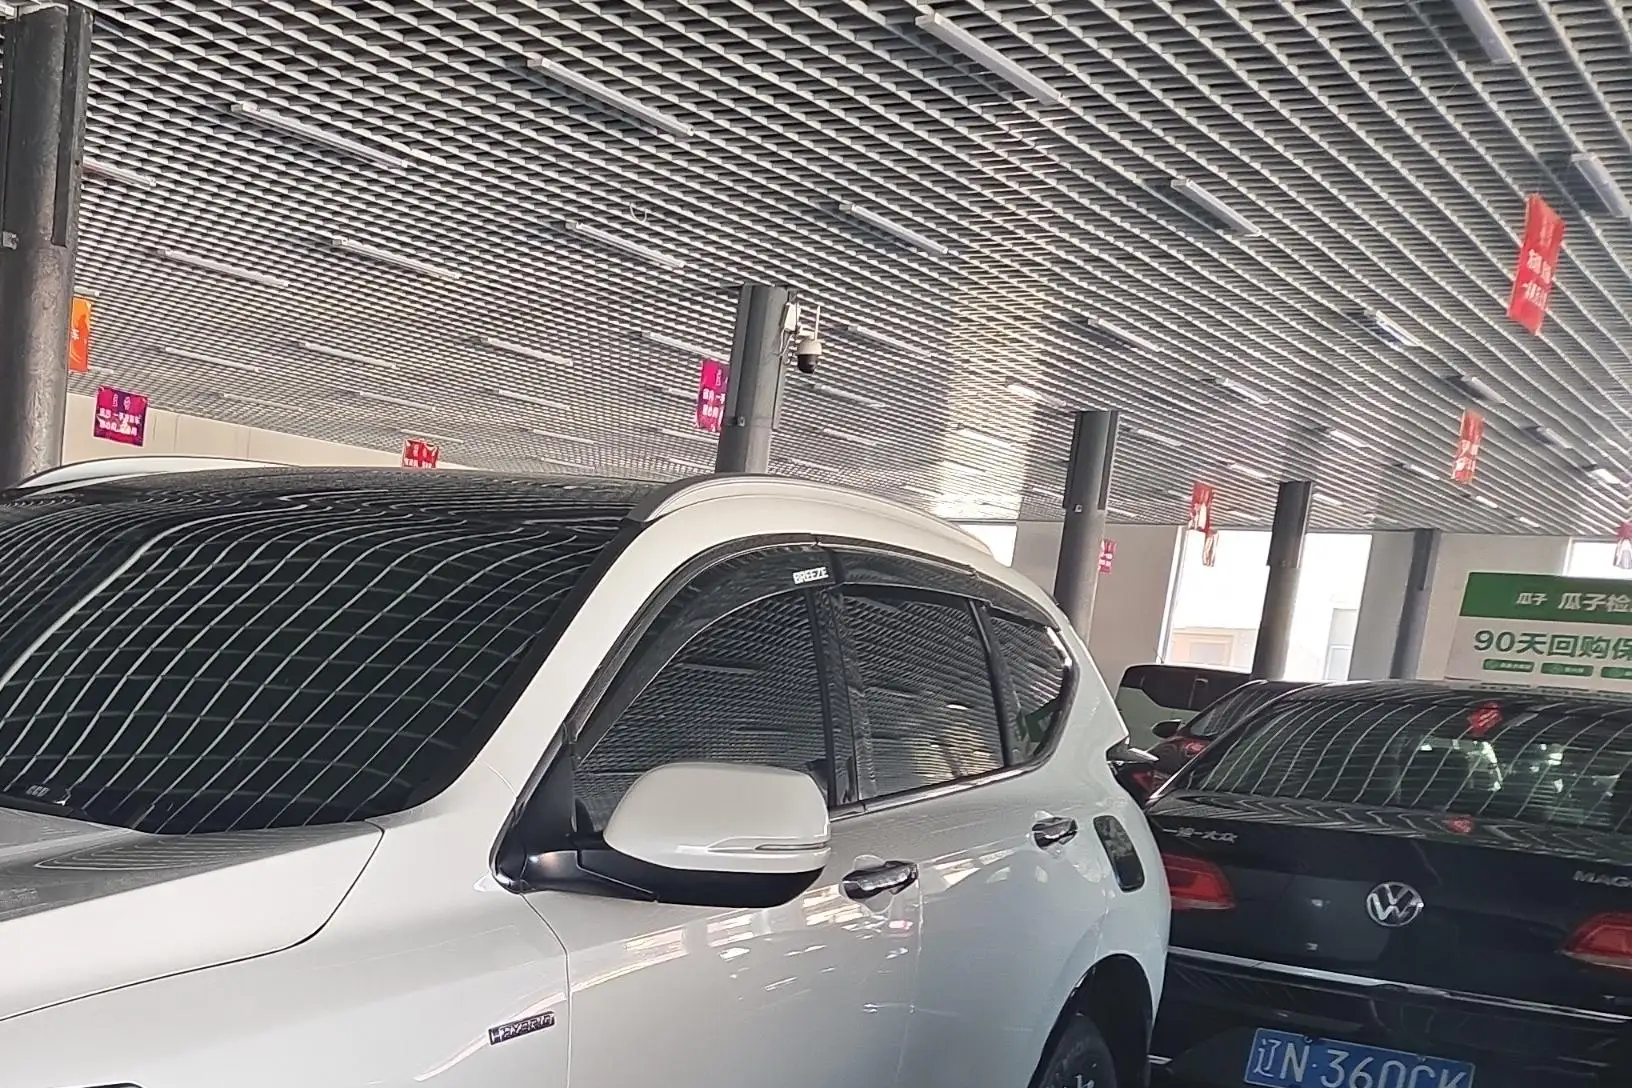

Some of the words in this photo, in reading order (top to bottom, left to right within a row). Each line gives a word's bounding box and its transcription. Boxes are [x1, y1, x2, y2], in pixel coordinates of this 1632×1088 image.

[792, 566, 829, 584] BREEZE
[1516, 592, 1548, 606] 瓜子
[1557, 592, 1632, 613] 瓜子检
